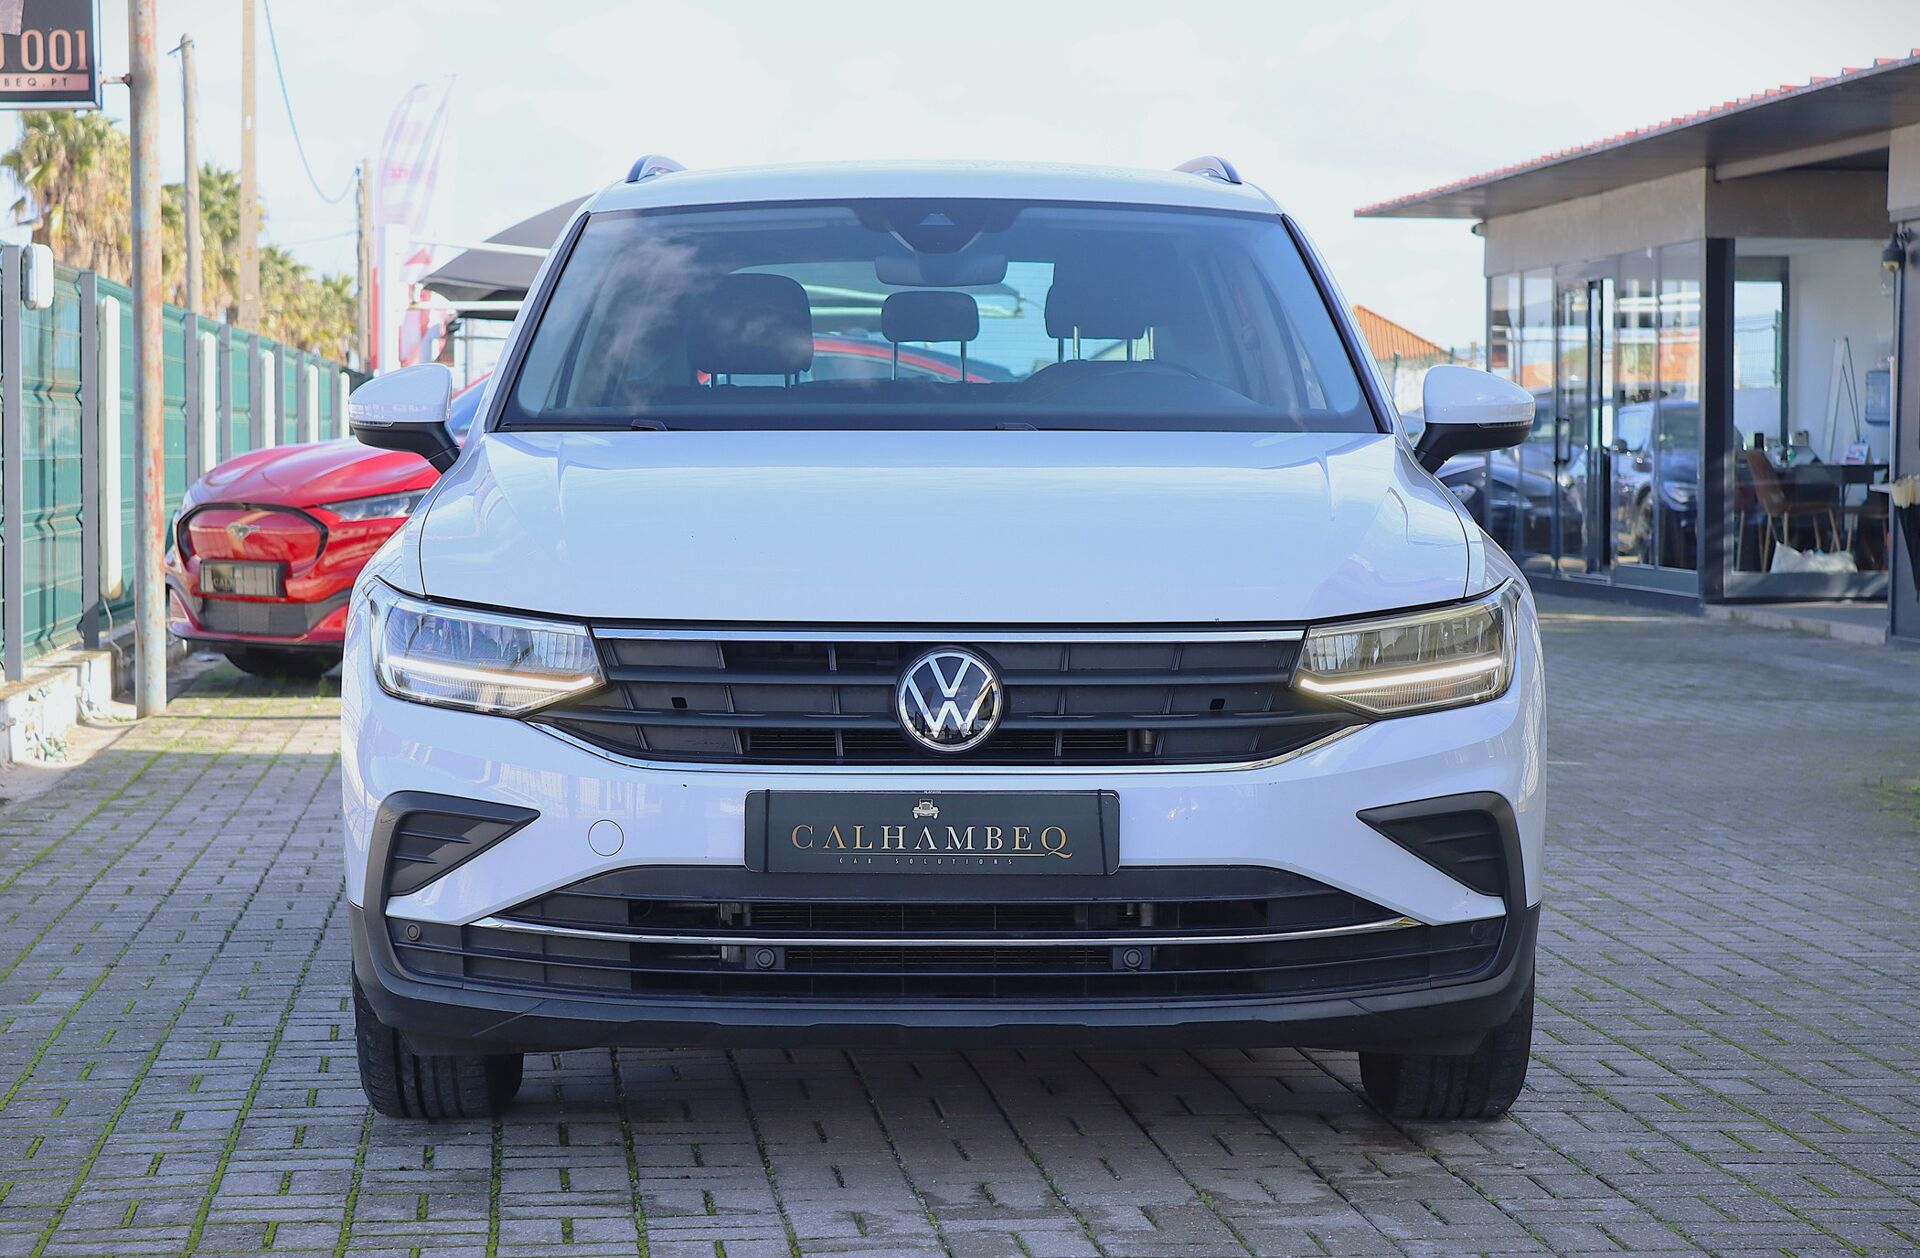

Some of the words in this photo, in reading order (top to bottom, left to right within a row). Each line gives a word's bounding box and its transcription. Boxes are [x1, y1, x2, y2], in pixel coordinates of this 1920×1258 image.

[20, 28, 89, 72] 001
[791, 824, 1073, 859] CALHAMBEQ
[895, 857, 1012, 865] SOLUTIONS
